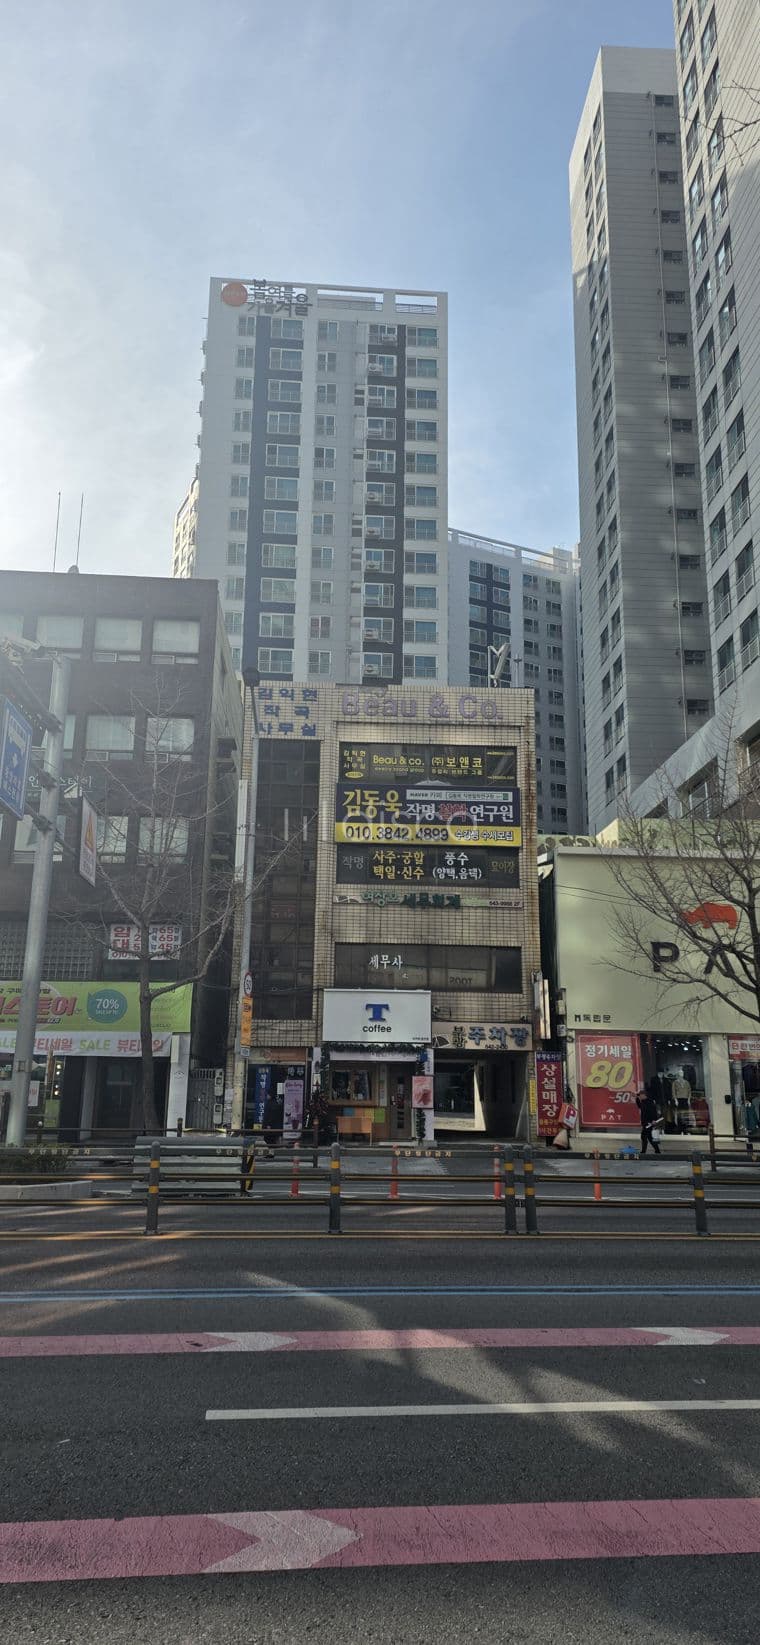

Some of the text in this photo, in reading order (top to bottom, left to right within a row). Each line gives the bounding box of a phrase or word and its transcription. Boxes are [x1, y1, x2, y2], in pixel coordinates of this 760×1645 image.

[257, 687, 318, 701] 김익현
[342, 692, 504, 720] Beau & Co.
[259, 723, 316, 737] 사무실
[372, 755, 425, 766] Beau & co.
[342, 789, 403, 820] 김동욱
[406, 803, 436, 821] 작명
[469, 804, 514, 823] 연구원
[345, 825, 449, 842] 010.3842.4899
[444, 852, 470, 866] 풍수
[368, 954, 404, 970] 세무사
[95, 998, 120, 1010] 70%
[364, 1003, 392, 1023] T
[362, 1024, 392, 1034] coffee
[80, 1039, 111, 1051] SALE
[585, 1044, 633, 1059] 정기세일
[585, 1060, 634, 1091] 80
[541, 1063, 559, 1117] 상설매장
